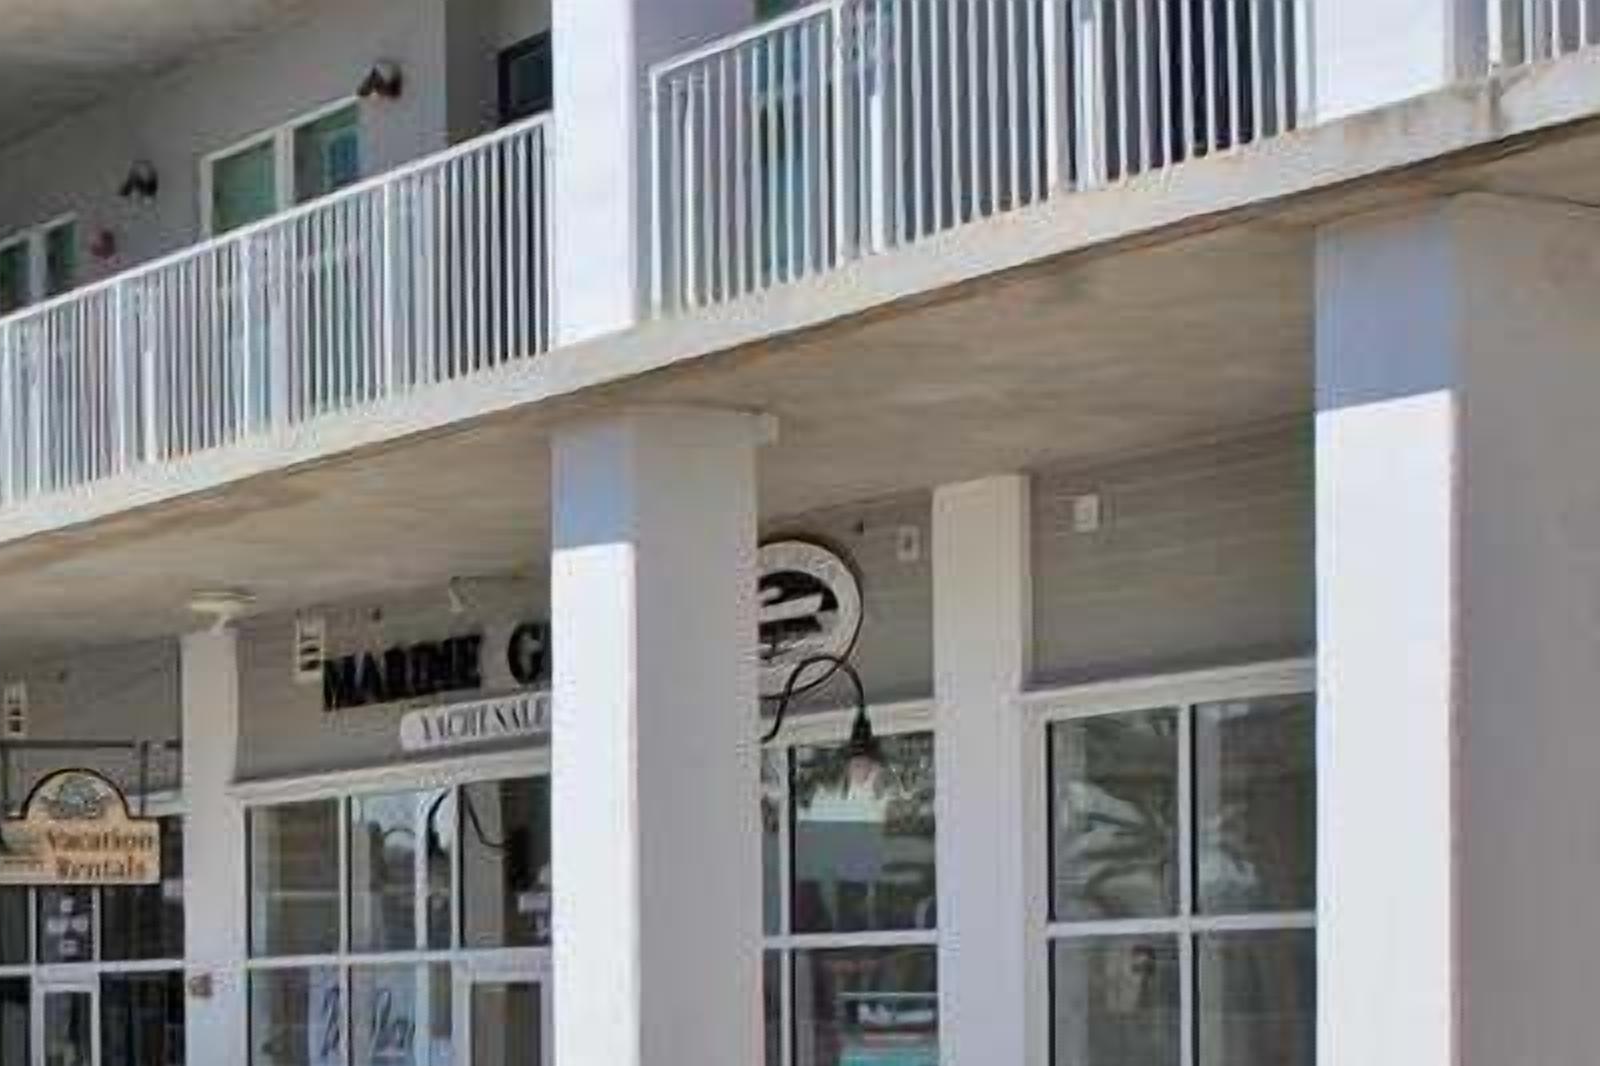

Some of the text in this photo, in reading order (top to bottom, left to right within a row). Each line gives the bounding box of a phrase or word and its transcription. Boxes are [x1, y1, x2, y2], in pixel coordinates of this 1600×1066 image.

[322, 633, 483, 713] MARINE
[46, 827, 154, 852] Vacation
[54, 853, 148, 879] Rentals
